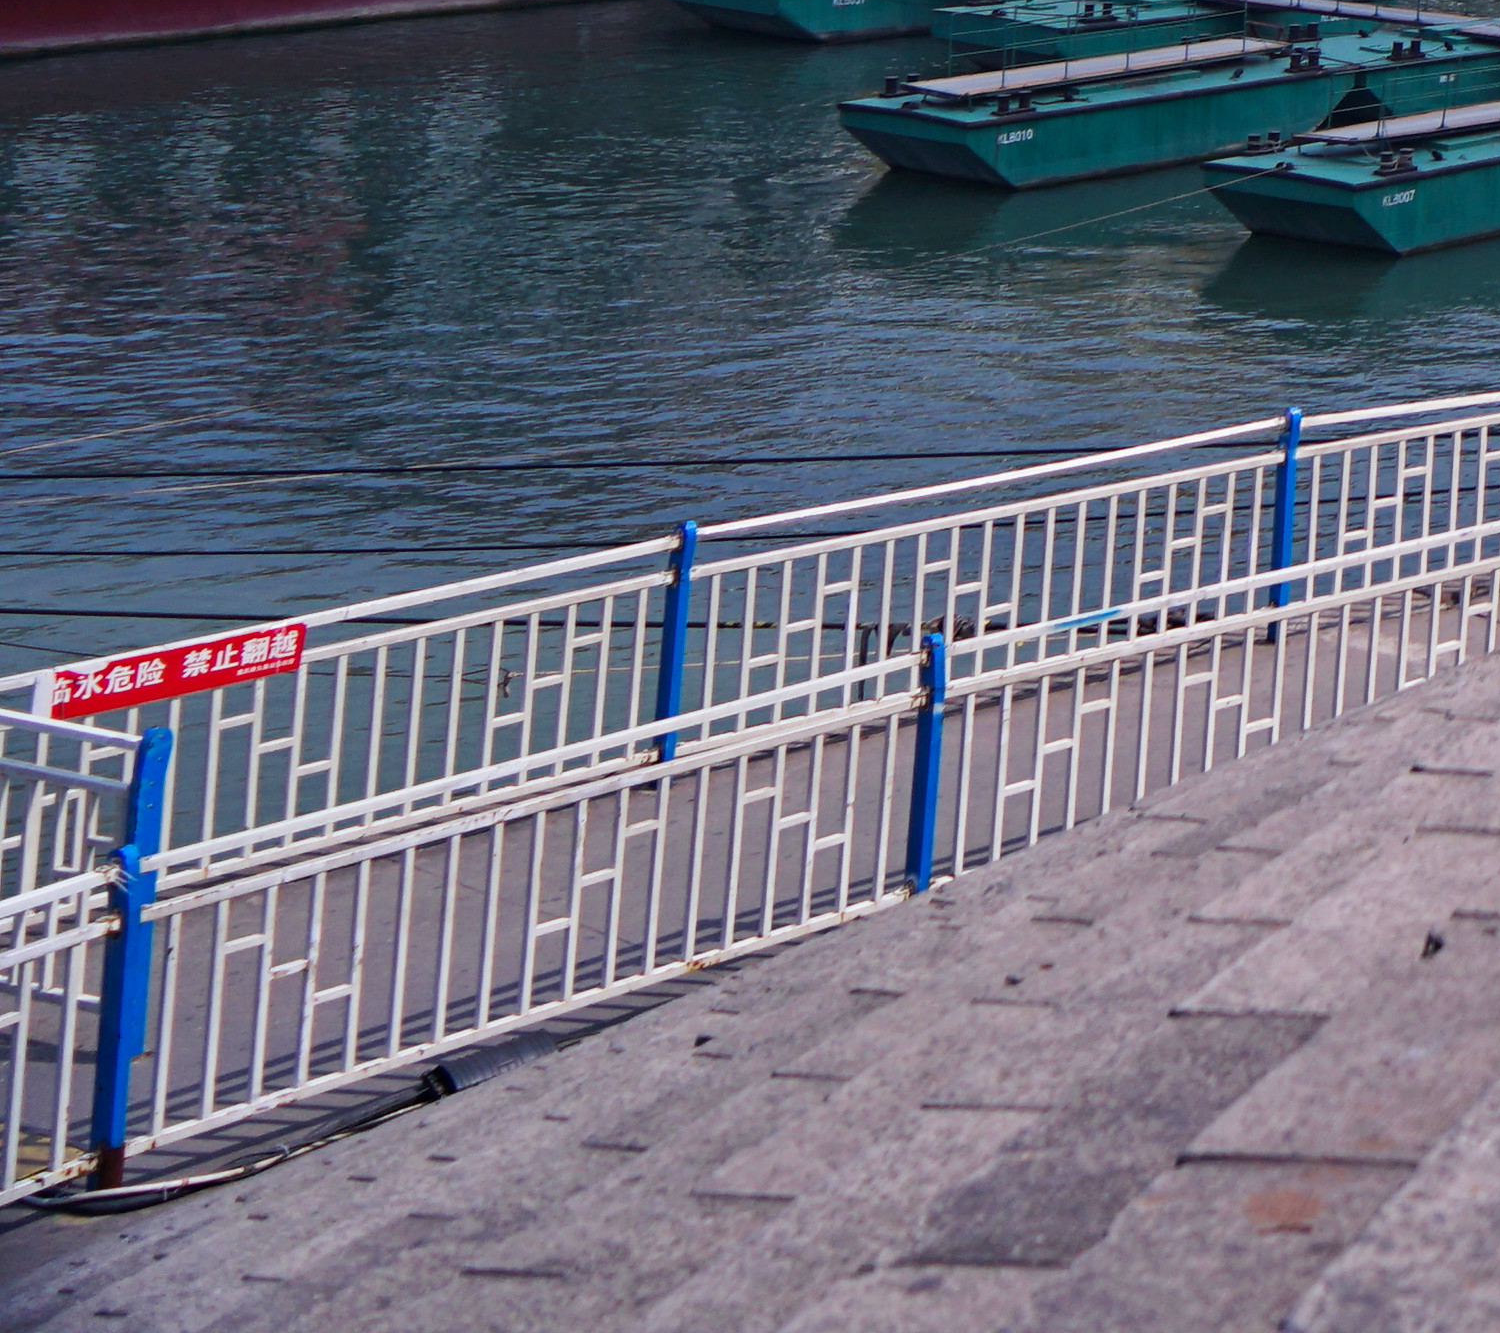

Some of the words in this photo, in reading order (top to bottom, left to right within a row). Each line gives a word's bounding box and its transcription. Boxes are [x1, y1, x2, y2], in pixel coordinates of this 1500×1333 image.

[53, 658, 167, 705] 临水危险
[181, 629, 300, 679] 禁止翻越
